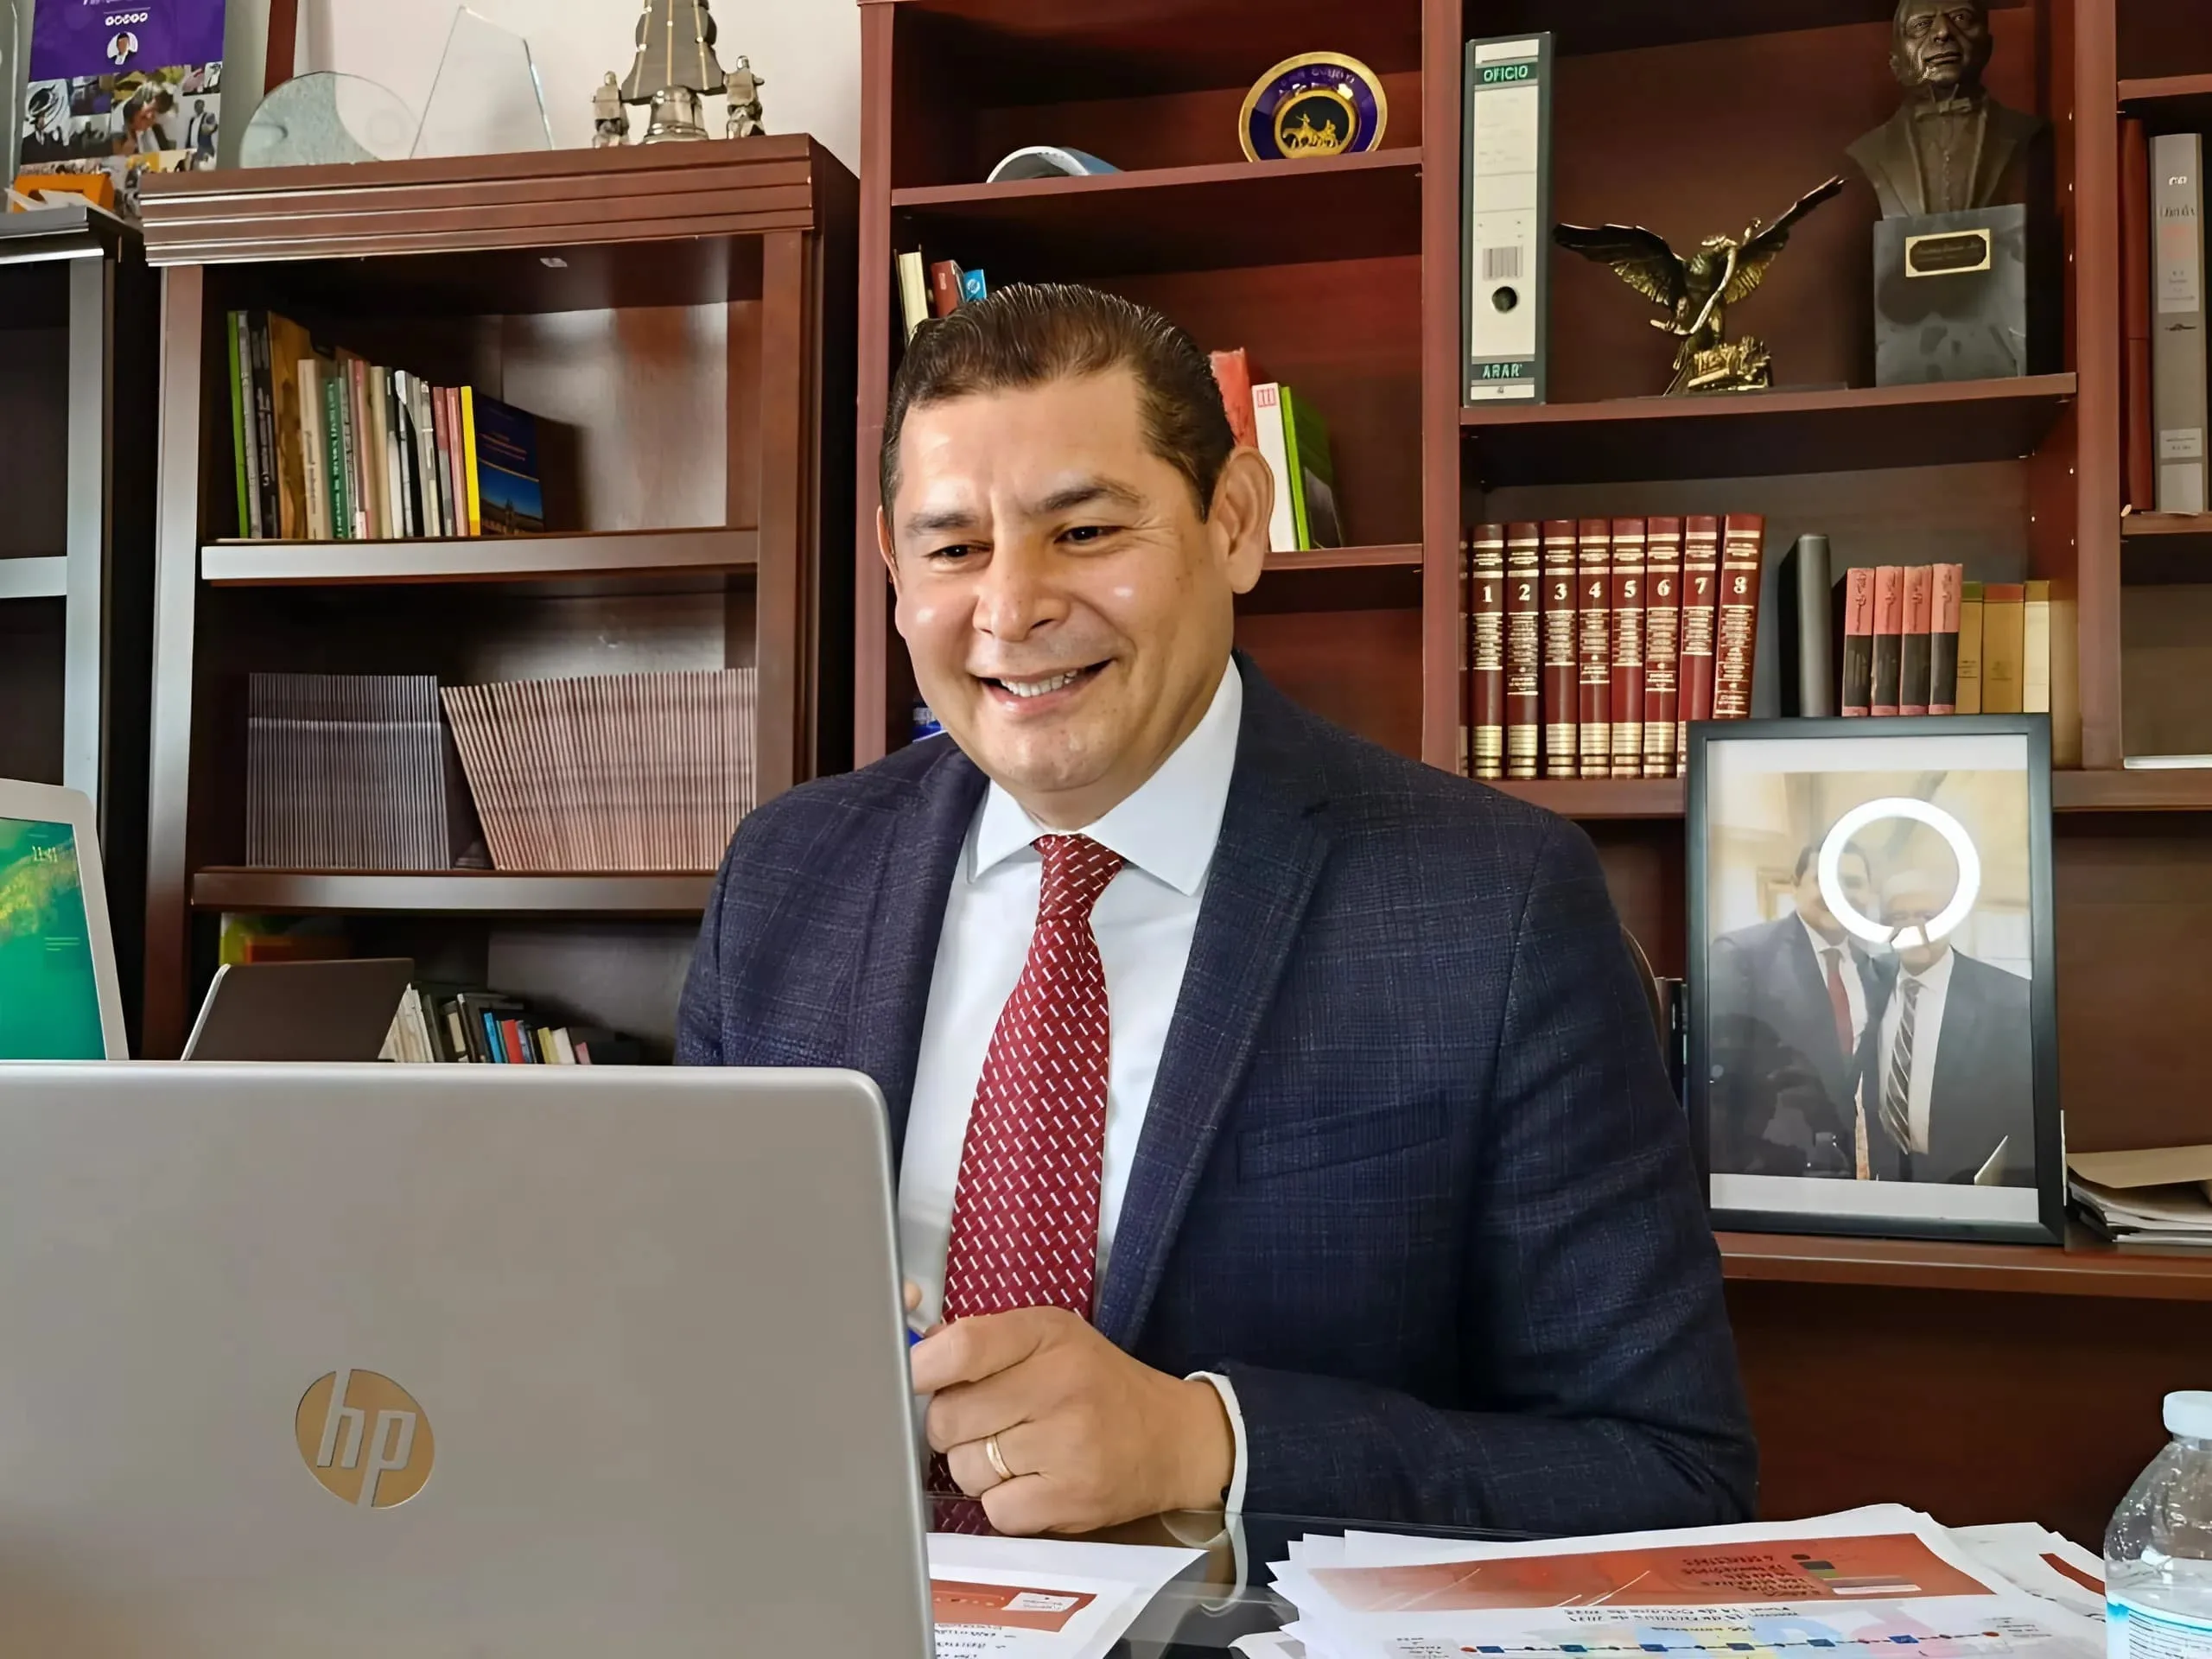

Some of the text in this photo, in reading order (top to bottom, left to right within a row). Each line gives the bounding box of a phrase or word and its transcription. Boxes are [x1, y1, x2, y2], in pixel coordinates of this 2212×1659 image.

[1484, 65, 1529, 83] OFICIO
[1482, 585, 1493, 603] 1
[1518, 583, 1531, 601] 2
[1554, 582, 1567, 601] 3
[1588, 581, 1601, 598] 4
[1624, 580, 1637, 598] 5
[1656, 579, 1670, 596] 6
[1694, 576, 1708, 594] 7
[1733, 576, 1747, 594] 8
[315, 1368, 417, 1509] hp
